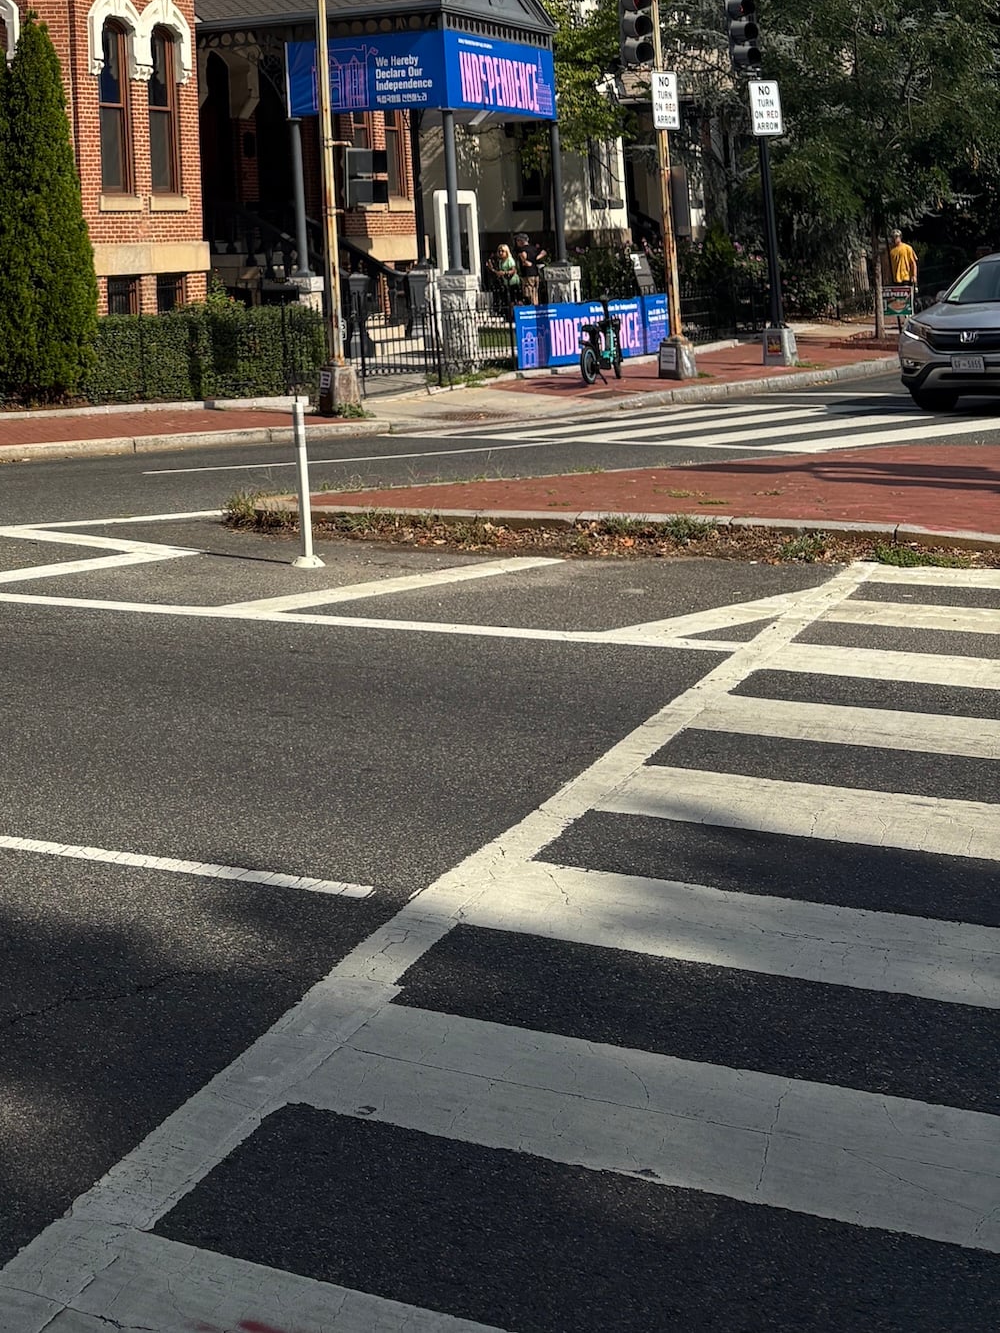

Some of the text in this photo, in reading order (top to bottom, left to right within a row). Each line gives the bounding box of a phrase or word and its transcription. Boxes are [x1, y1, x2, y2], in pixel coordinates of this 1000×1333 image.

[375, 54, 419, 67] We Hereby
[375, 66, 423, 79] Declare Our
[376, 78, 433, 92] Independence
[459, 51, 539, 111] INDEPENDENCE
[658, 77, 670, 87] NO
[657, 90, 672, 99] TURN
[758, 86, 770, 95] NO
[655, 102, 676, 112] ON RED
[757, 98, 774, 107] TURN
[754, 110, 778, 119] ON RED
[657, 115, 676, 124] ARROW
[756, 122, 778, 130] ARROW
